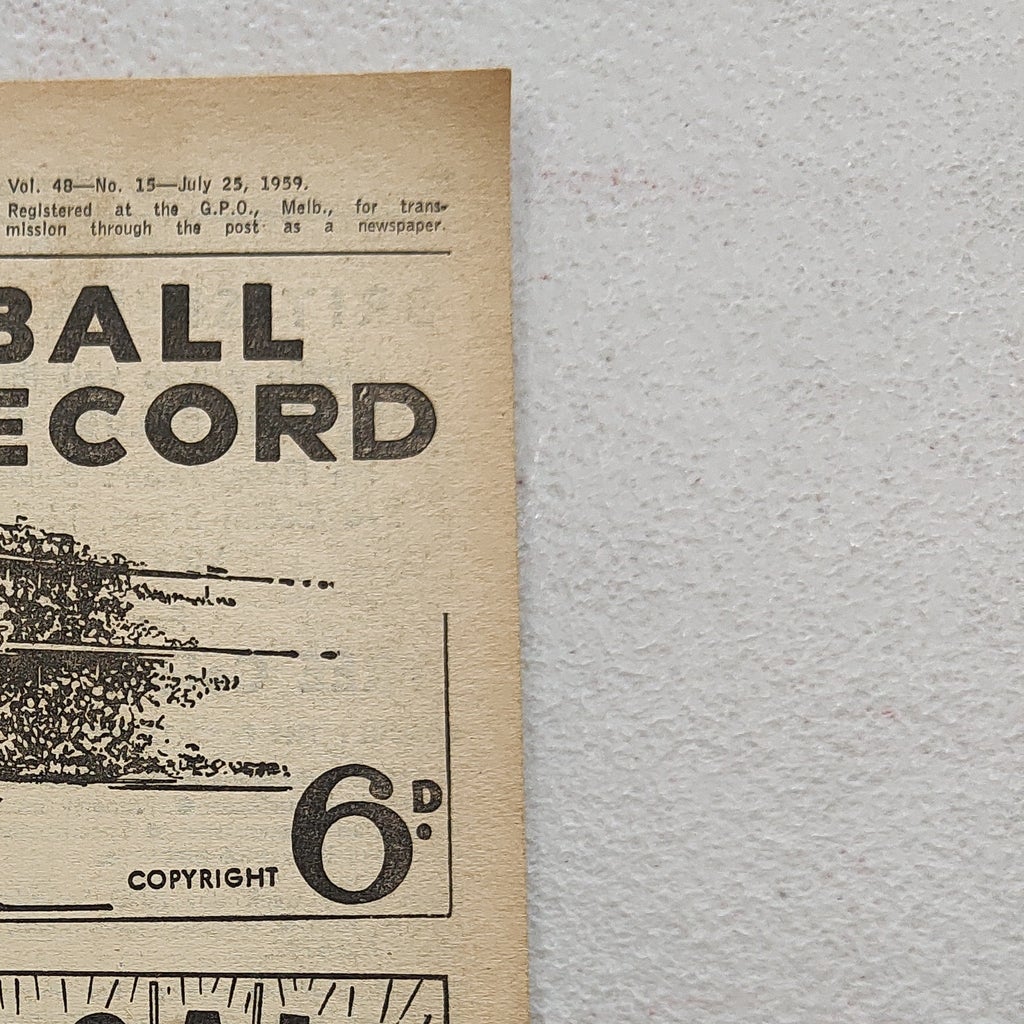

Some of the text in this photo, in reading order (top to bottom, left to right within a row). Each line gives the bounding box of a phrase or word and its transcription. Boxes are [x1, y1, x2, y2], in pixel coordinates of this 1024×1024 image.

[8, 178, 39, 193] Vol.
[223, 176, 248, 193] 25,
[262, 176, 308, 190] 1959.
[9, 198, 448, 220] Registered at the G.P.O., Melb., for trans-
[6, 220, 445, 237] mission through the post as a newspaper.
[128, 867, 278, 890] COPYRIGHT
